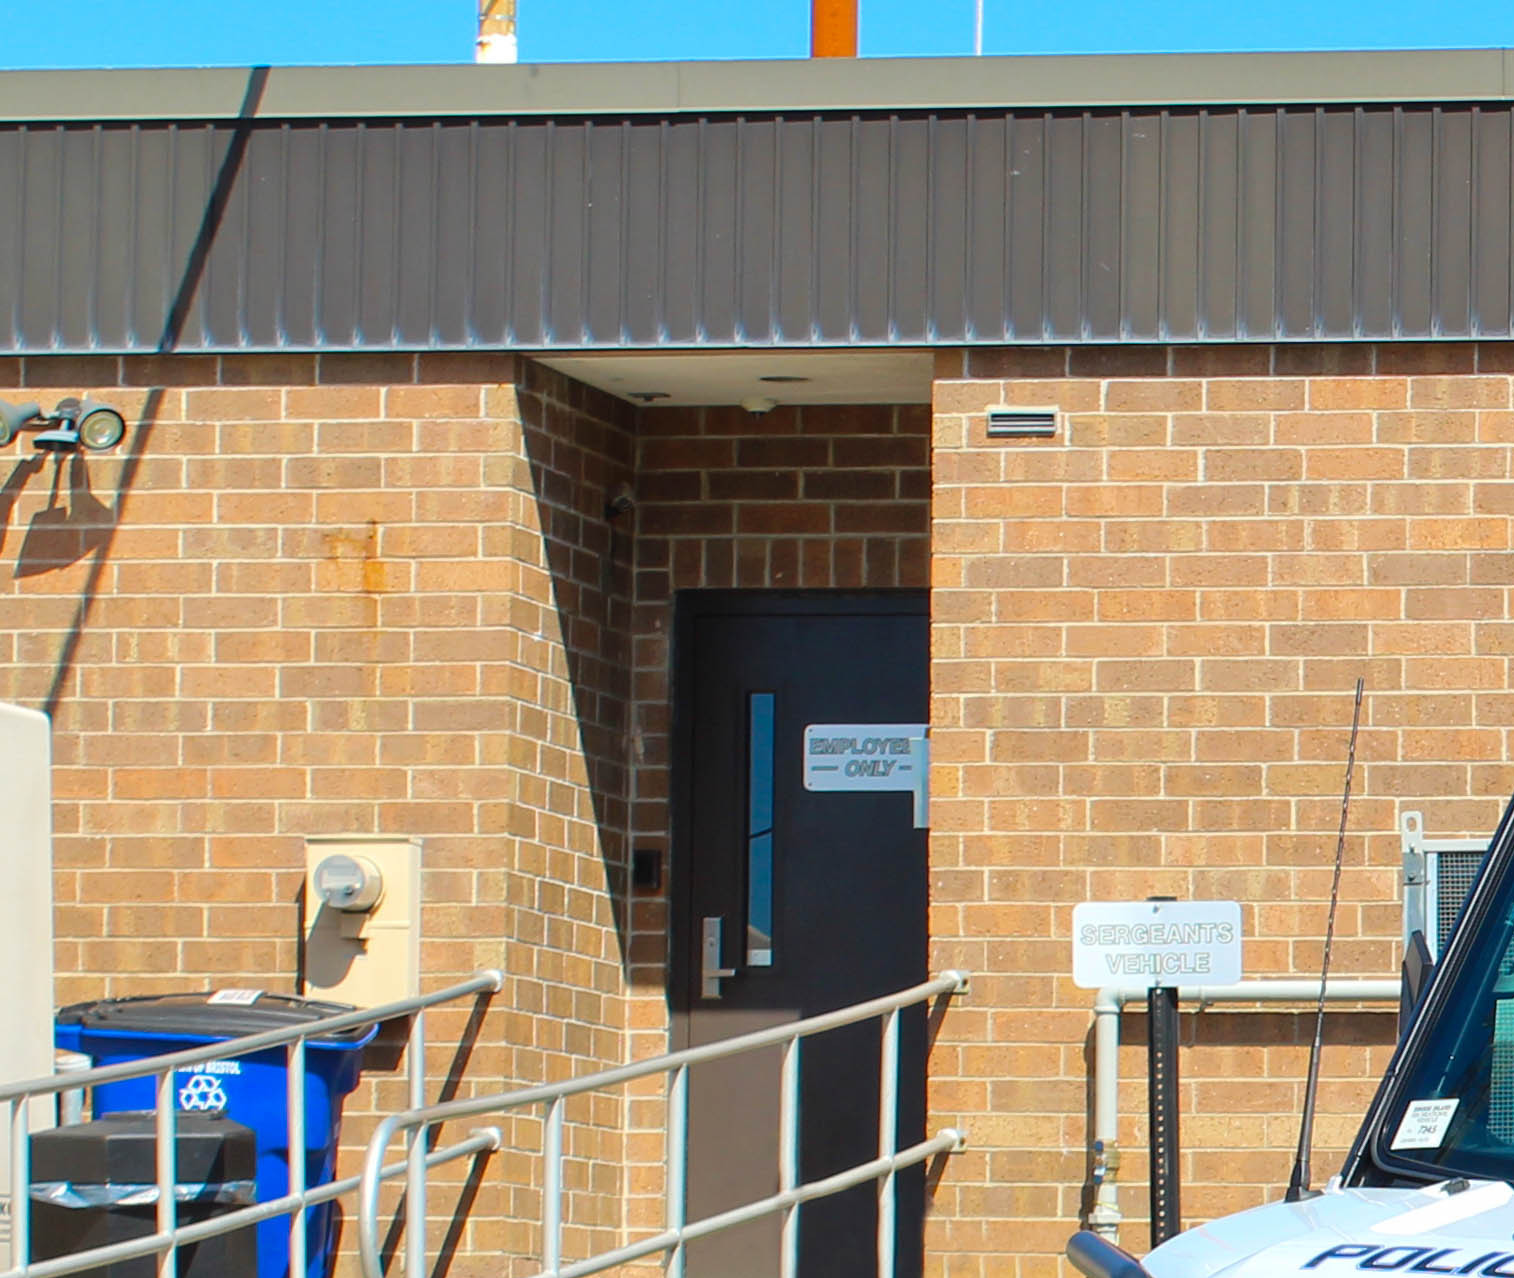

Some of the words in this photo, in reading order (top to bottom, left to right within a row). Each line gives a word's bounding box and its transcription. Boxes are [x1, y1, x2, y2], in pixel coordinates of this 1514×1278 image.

[809, 737, 912, 755] EMPLOYEE
[844, 759, 897, 777] ONLY
[1080, 922, 1234, 946] SERGEANTS
[1105, 952, 1211, 975] VEHICLE
